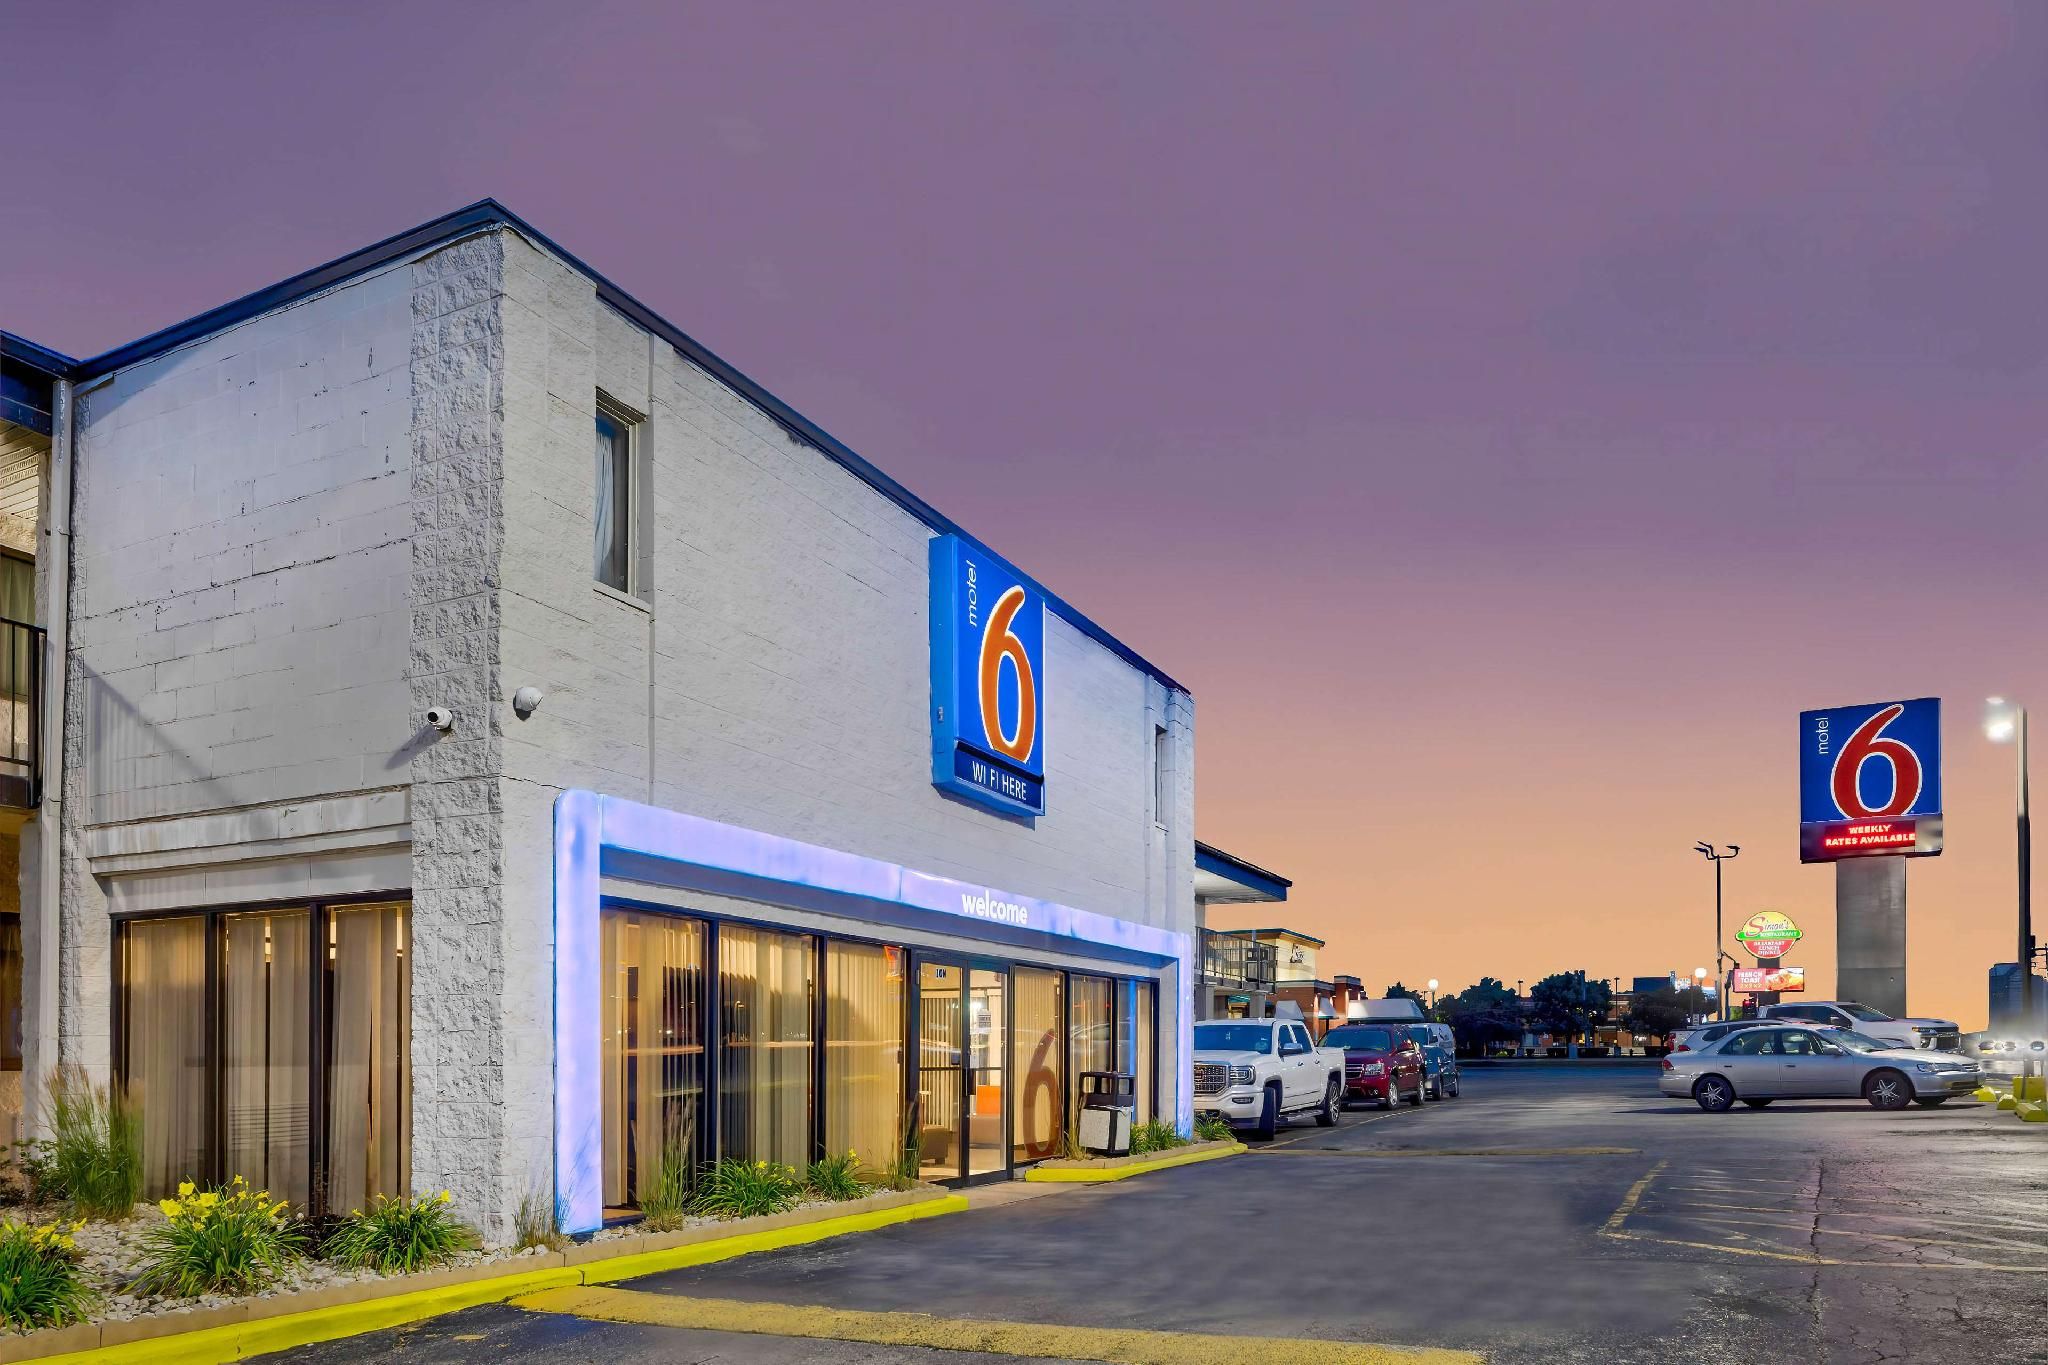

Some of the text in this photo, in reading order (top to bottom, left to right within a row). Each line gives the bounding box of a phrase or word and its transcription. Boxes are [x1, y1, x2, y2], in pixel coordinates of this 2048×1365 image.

[966, 559, 1036, 764] motel 6
[972, 760, 1027, 801] WI FI HERE
[1815, 703, 1923, 820] motel 6
[1825, 833, 1916, 847] RATES AVAILABLE
[1849, 824, 1892, 834] WEEKLY
[961, 889, 1028, 925] welcome
